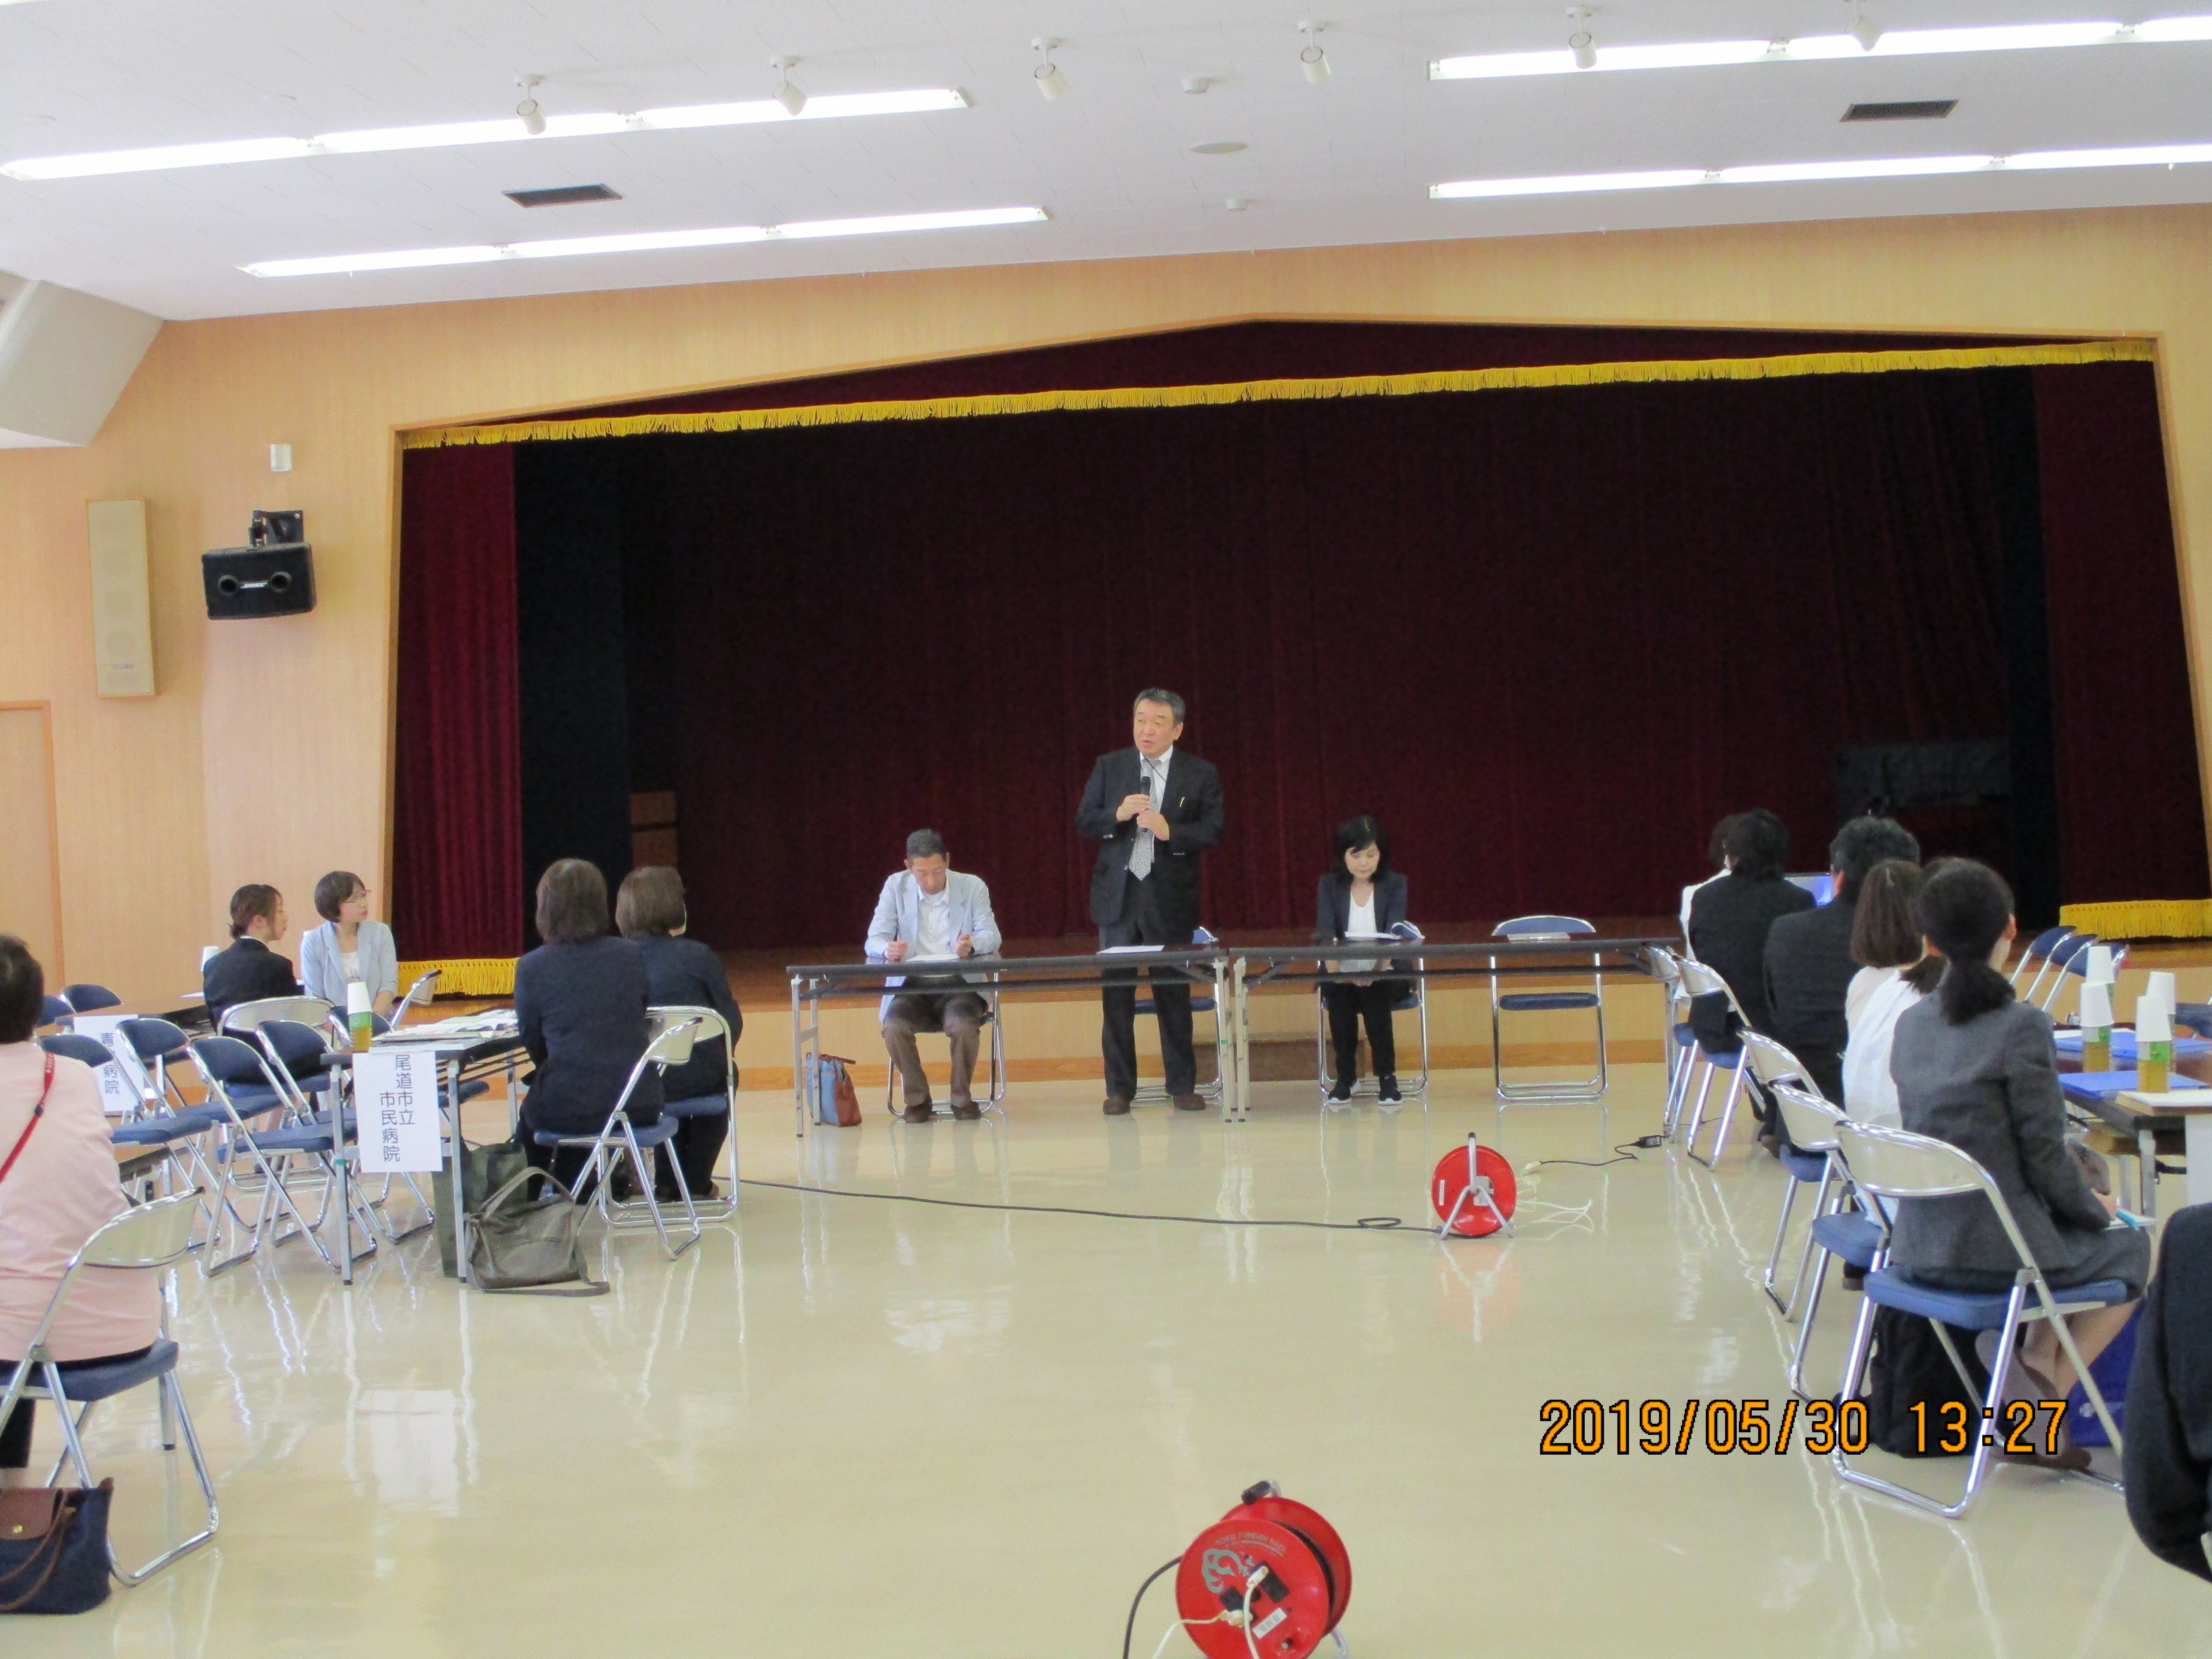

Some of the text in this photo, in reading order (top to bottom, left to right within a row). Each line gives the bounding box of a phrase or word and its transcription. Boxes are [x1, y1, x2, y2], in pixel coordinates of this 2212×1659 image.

[100, 1032, 120, 1094] 青病院
[395, 1054, 415, 1125] 尾道市立
[379, 1091, 400, 1162] 市民病院
